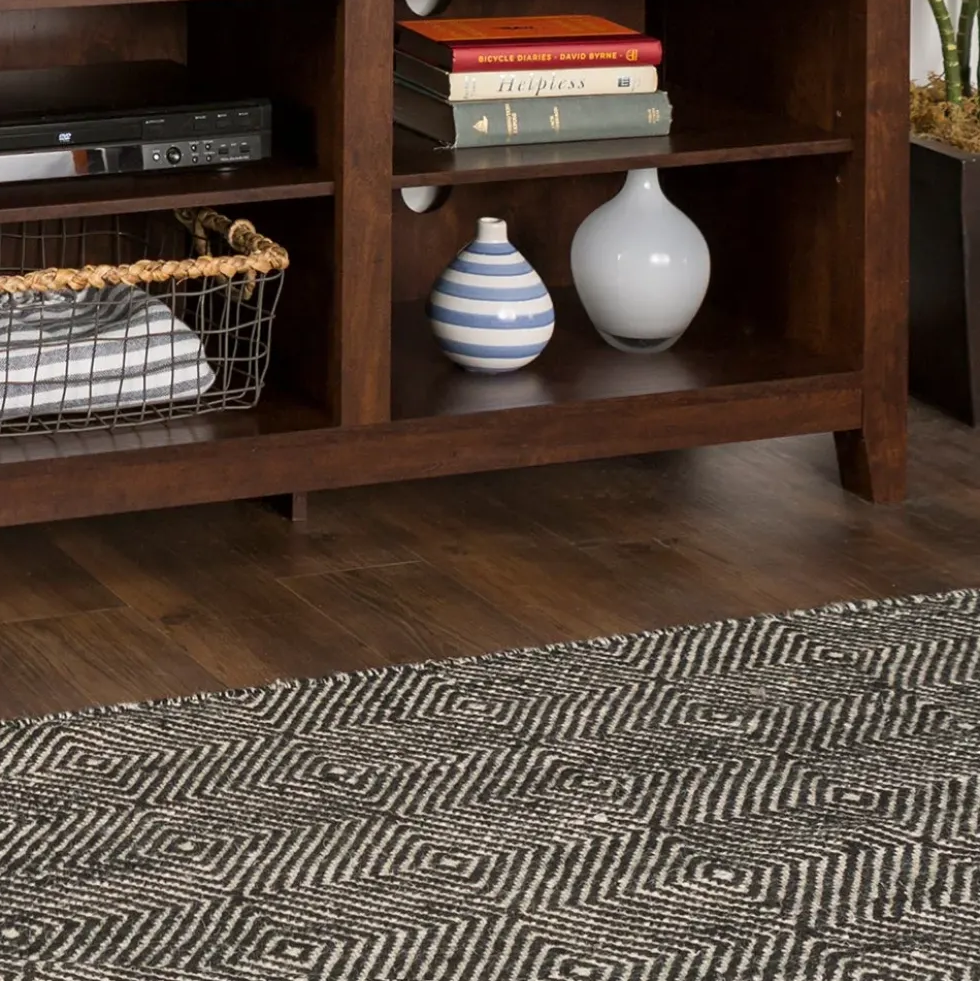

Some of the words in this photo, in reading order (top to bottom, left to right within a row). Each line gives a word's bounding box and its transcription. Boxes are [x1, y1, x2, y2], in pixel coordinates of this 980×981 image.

[477, 54, 515, 64] BICYCLE
[516, 53, 552, 63] DIARIES
[559, 52, 586, 61] DAVID
[588, 51, 617, 60] BYRNE
[497, 75, 586, 96] Helpless
